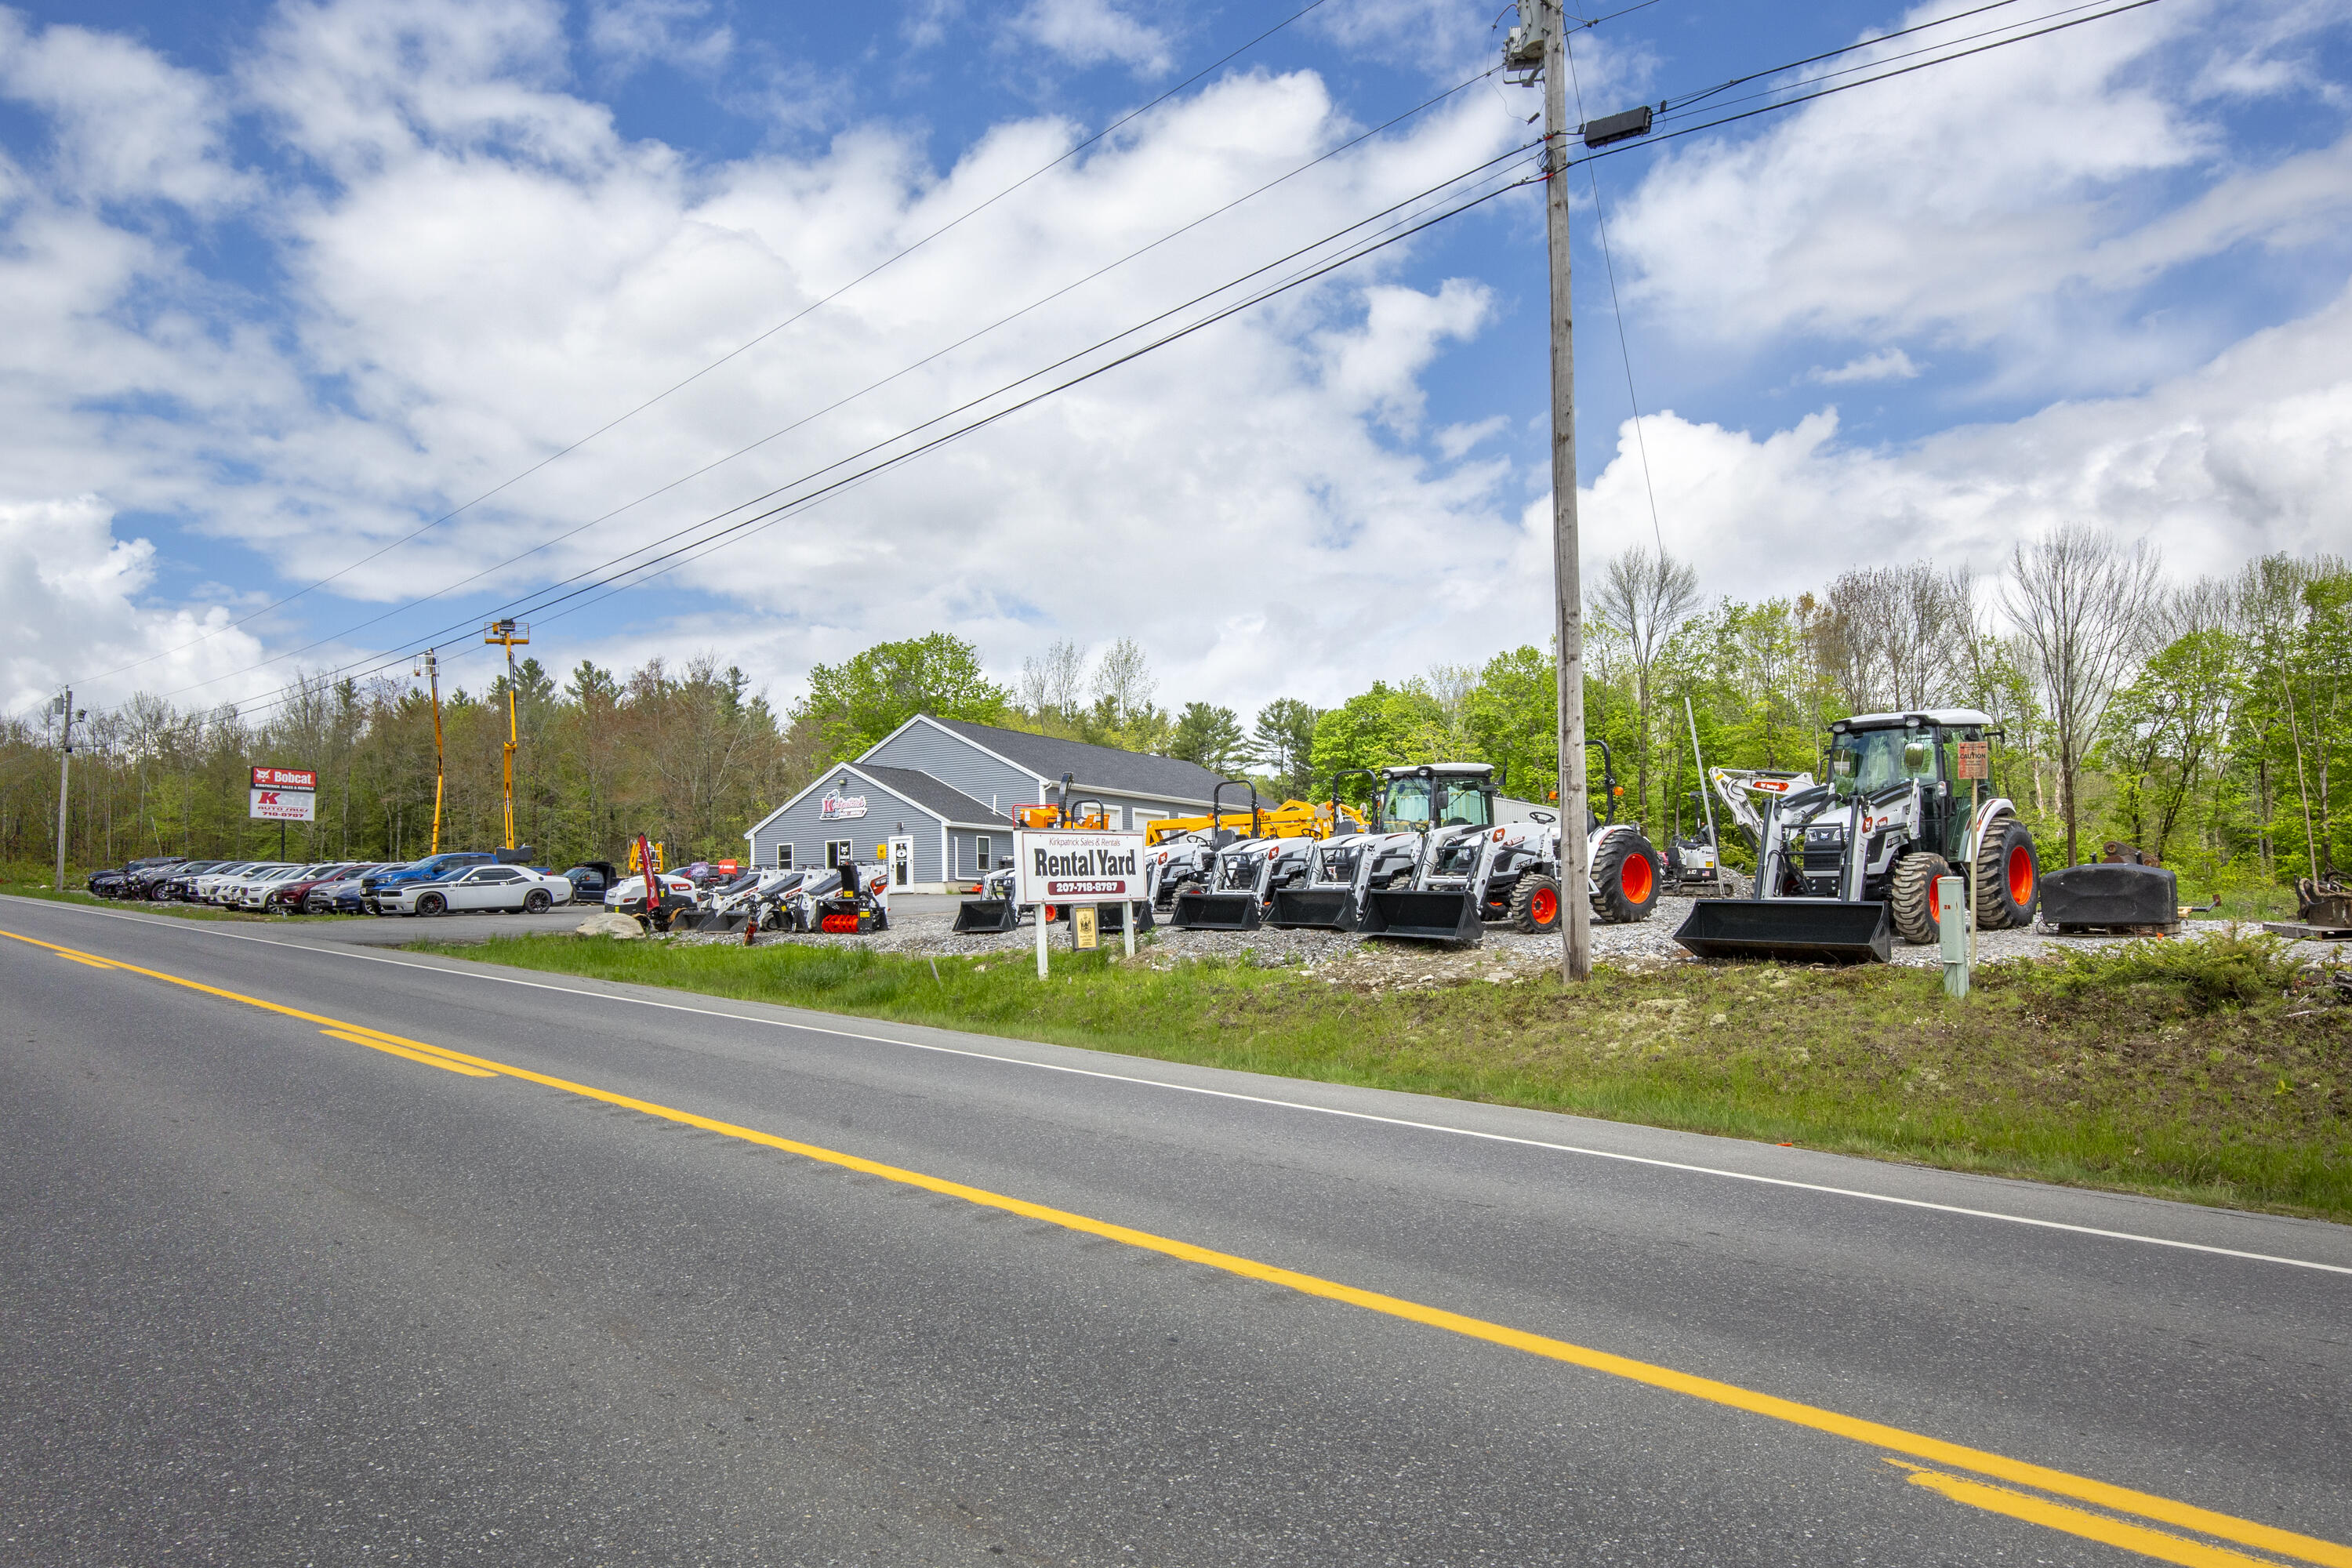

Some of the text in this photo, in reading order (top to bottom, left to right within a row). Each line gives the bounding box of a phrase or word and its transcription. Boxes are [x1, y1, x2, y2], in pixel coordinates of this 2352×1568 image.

[274, 771, 312, 785] Bobcat
[1049, 837, 1080, 847] Kirkpatrick
[1102, 838, 1120, 847] Rentals
[1034, 848, 1136, 877] Rental Yard
[1056, 882, 1118, 892] 207-718-8787
